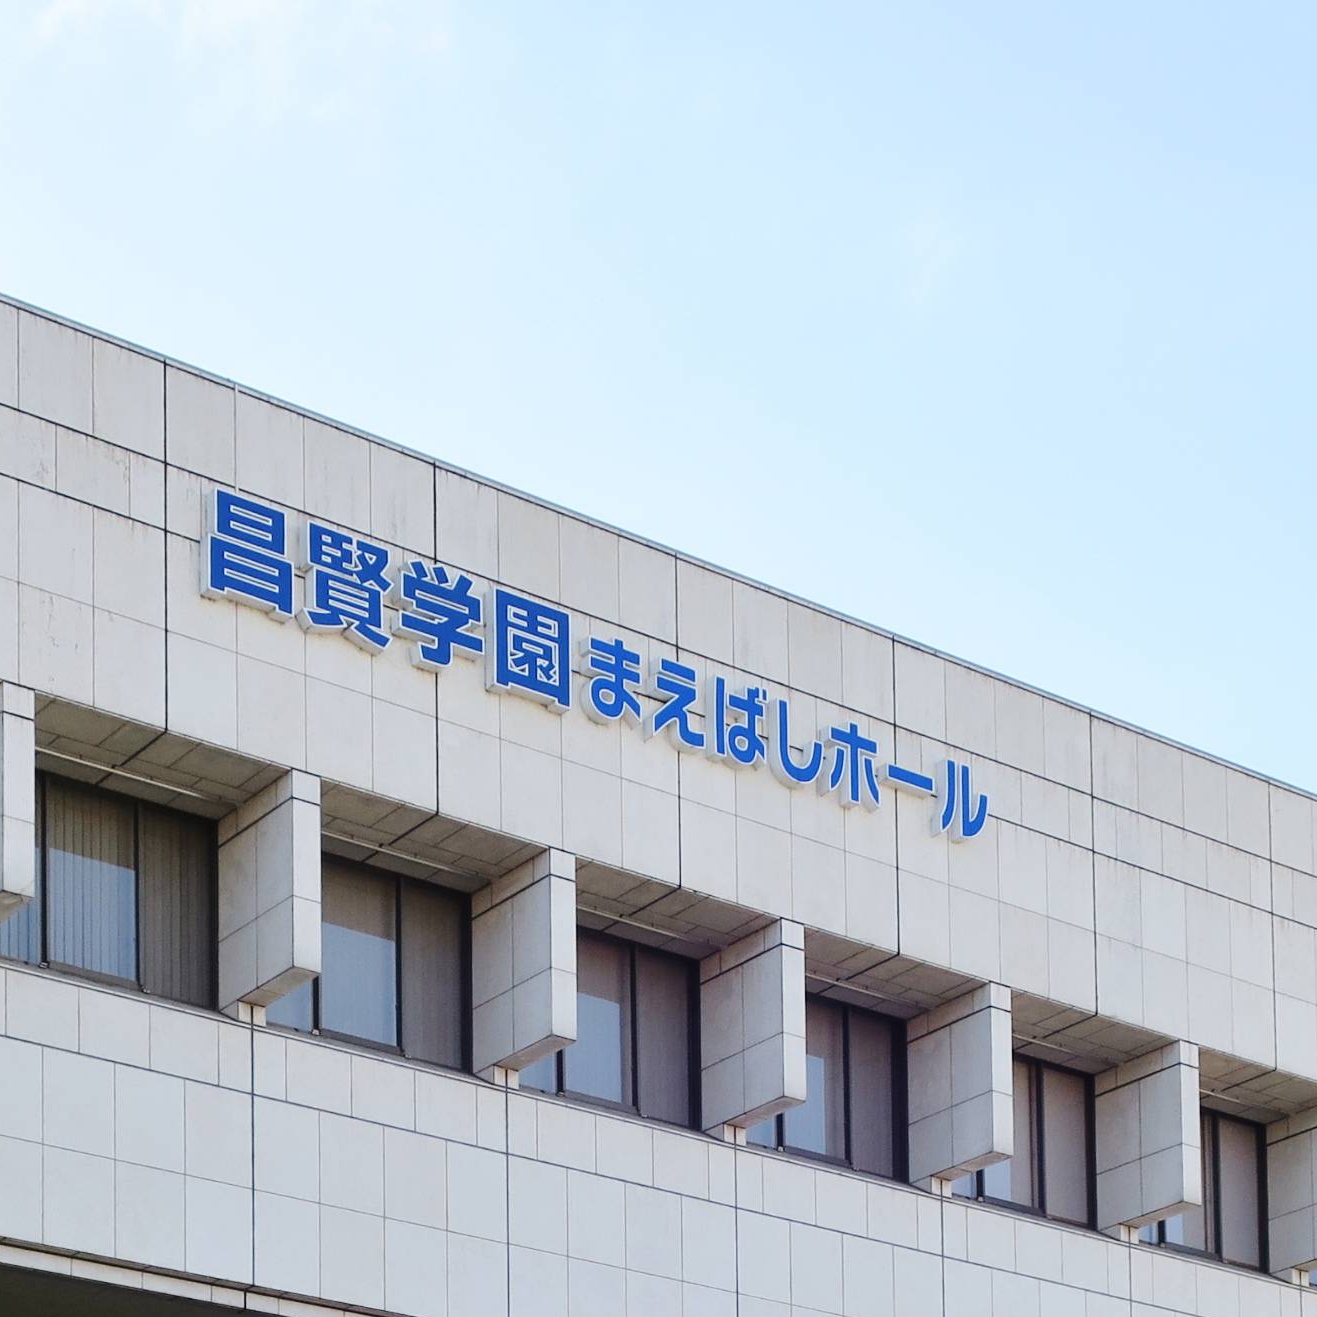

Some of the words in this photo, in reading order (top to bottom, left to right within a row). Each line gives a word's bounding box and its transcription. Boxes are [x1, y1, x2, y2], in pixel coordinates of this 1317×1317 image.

[207, 489, 989, 839] 昌賢学園まえばしホール
